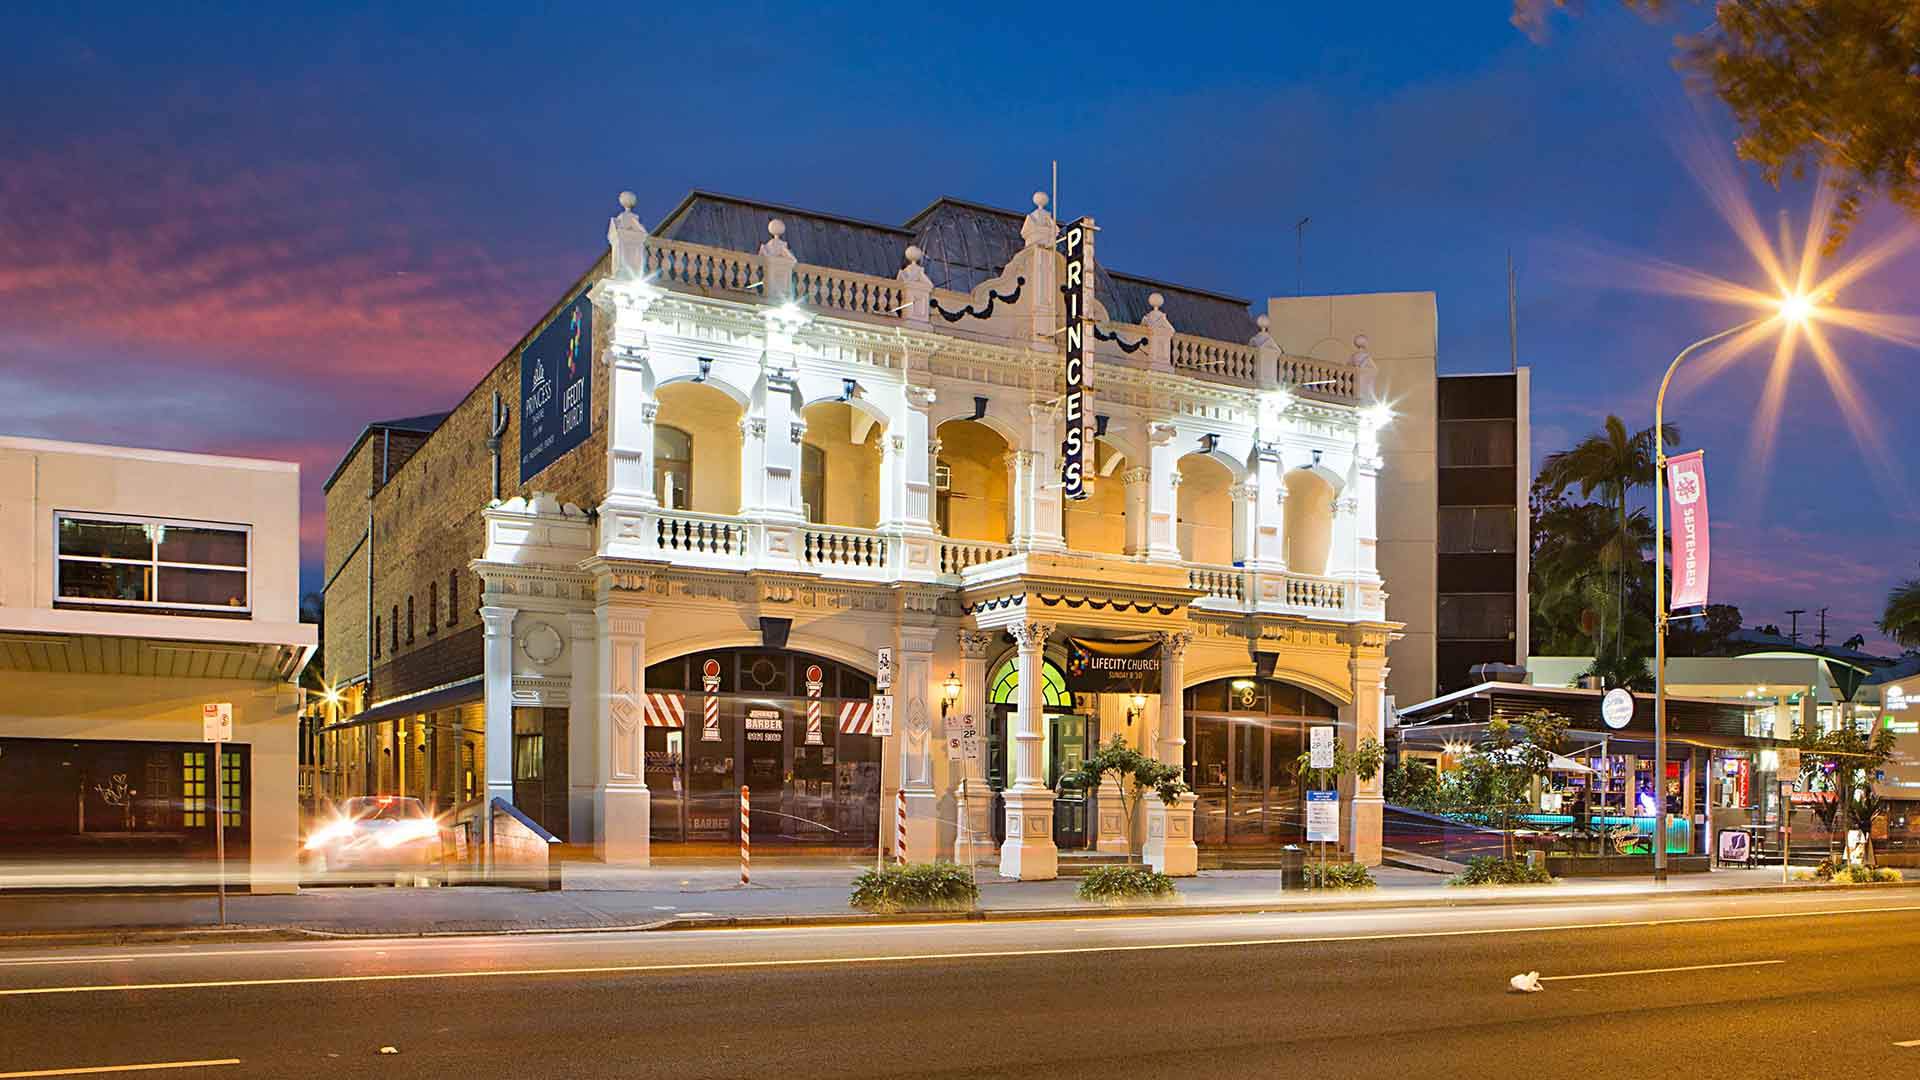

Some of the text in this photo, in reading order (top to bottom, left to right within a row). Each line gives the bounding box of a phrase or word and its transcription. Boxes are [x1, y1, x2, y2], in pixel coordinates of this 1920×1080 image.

[1065, 227, 1082, 491] PRINCESS
[1683, 507, 1696, 587] SEPTEMBER
[1091, 657, 1160, 671] LIFECITY CHURCH
[1242, 687, 1254, 705] 8
[745, 718, 783, 731] BARBER
[963, 730, 976, 739] 2P
[693, 816, 730, 830] BARBER
